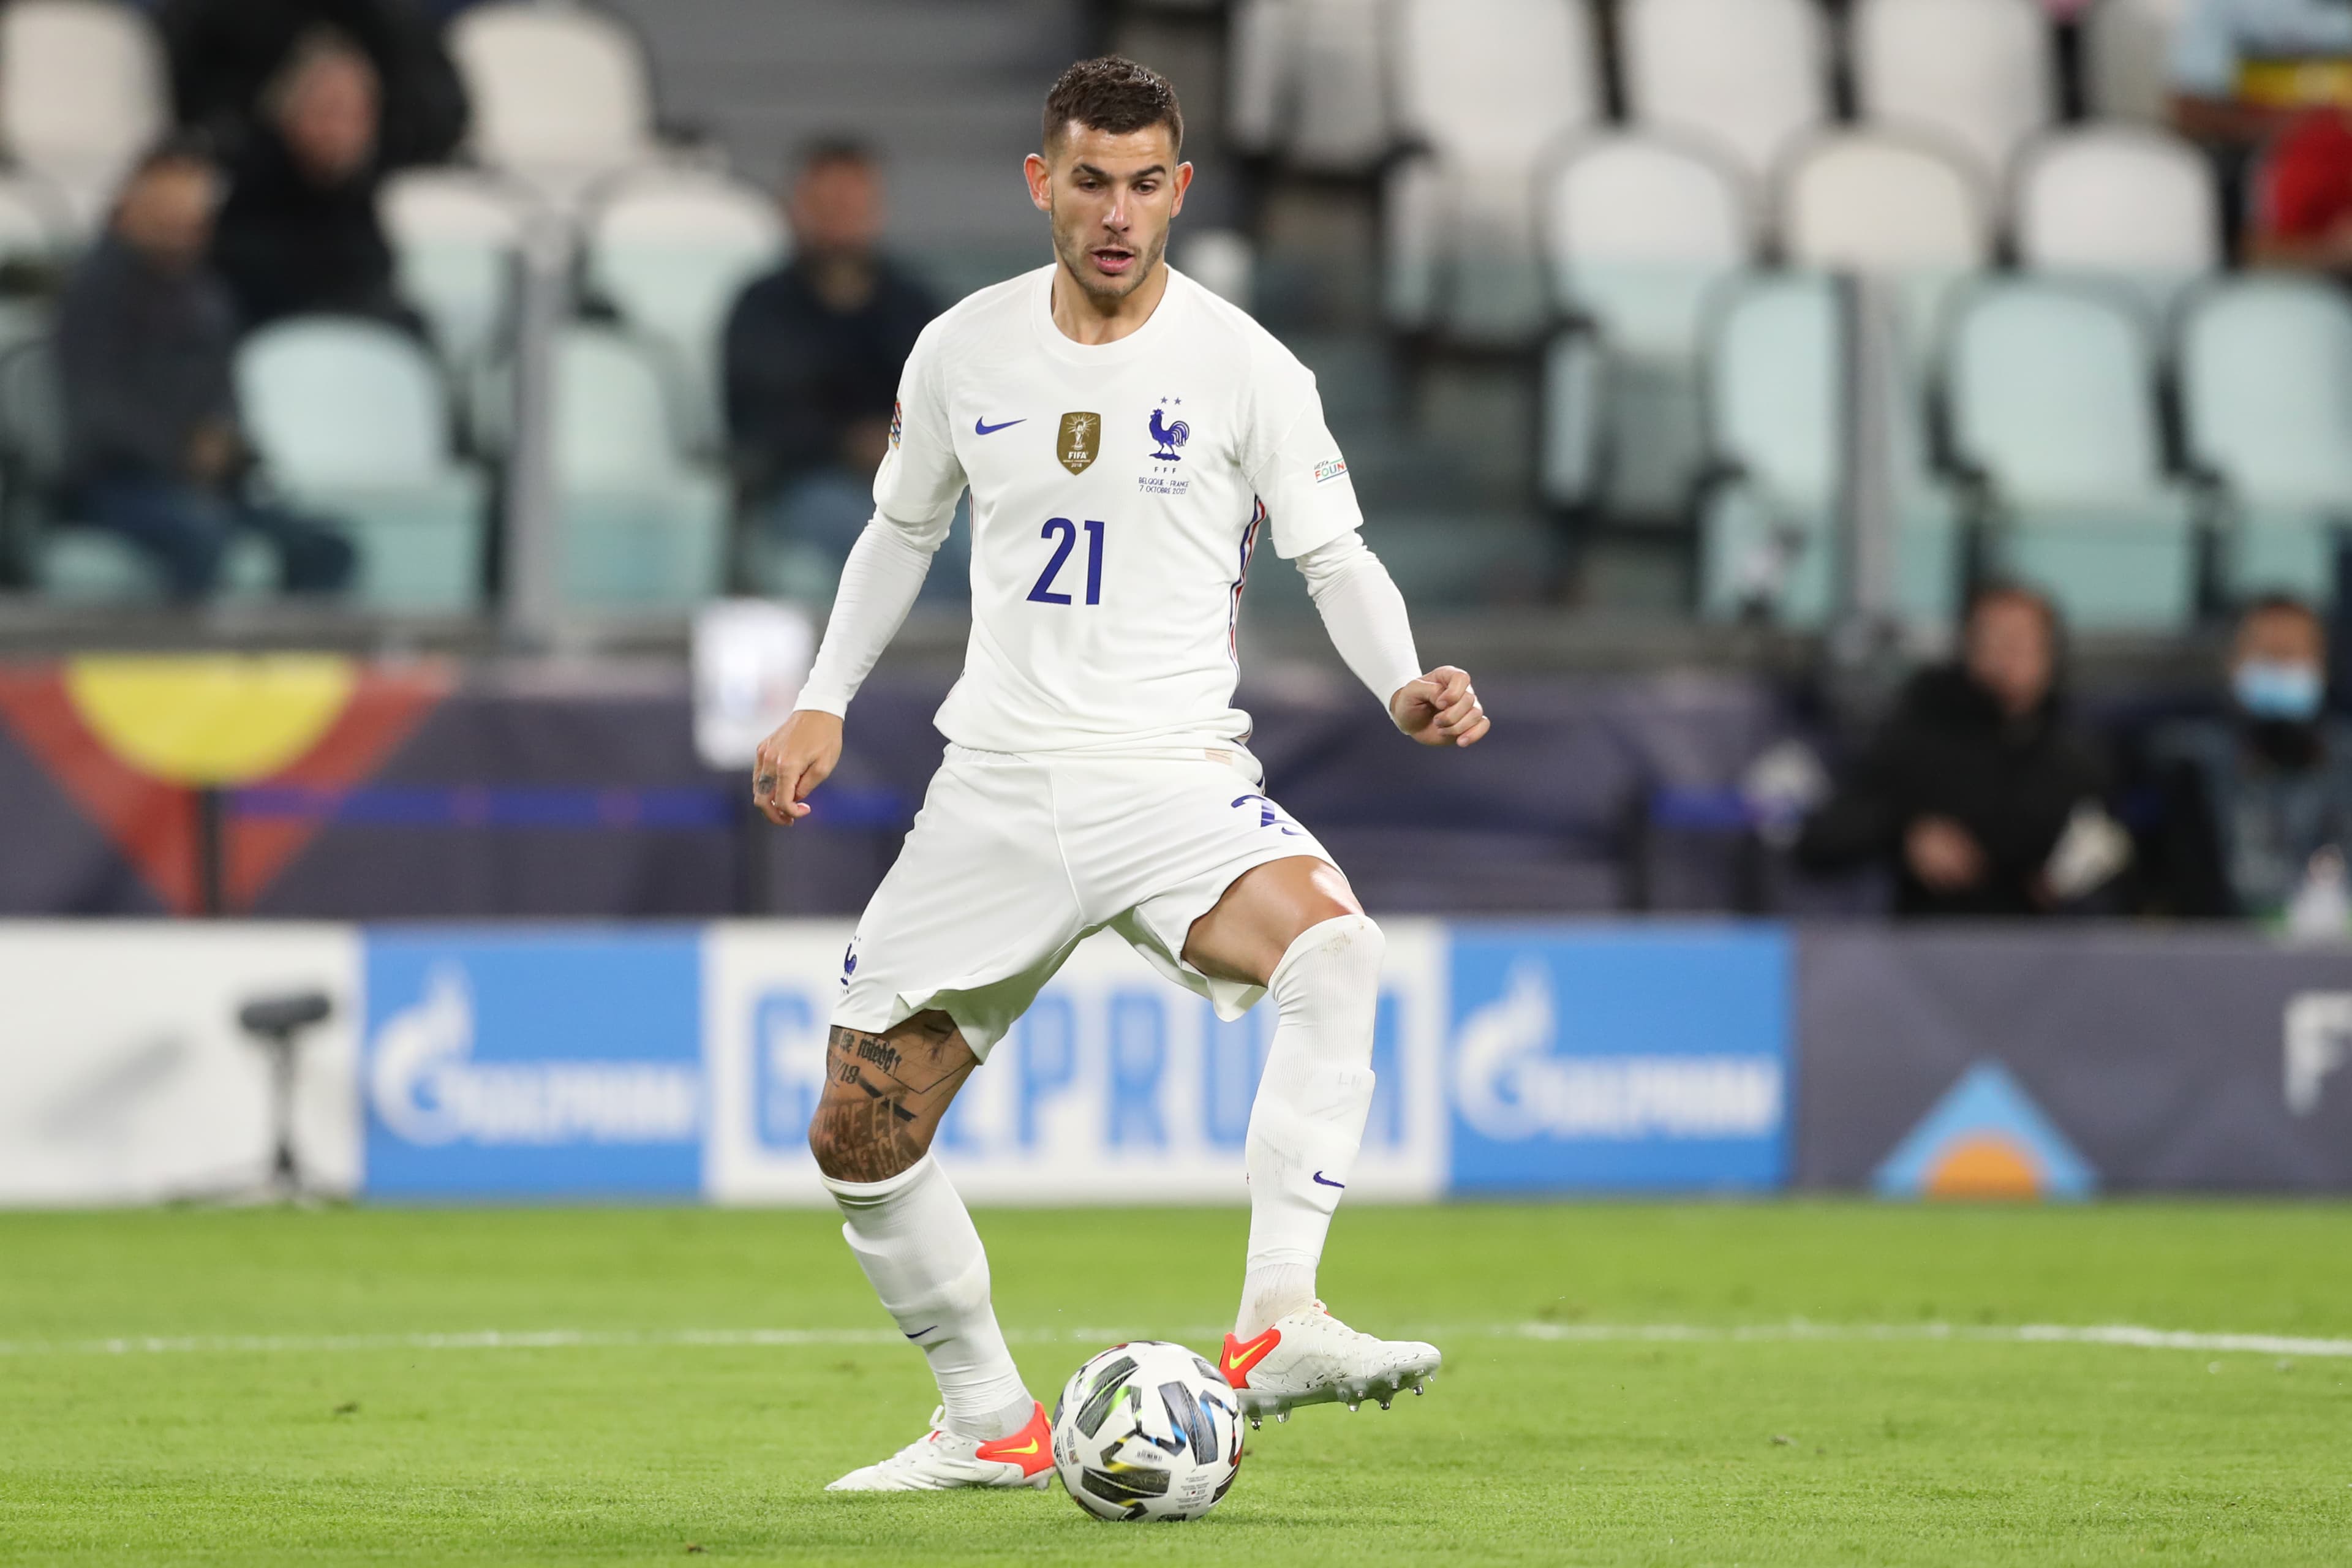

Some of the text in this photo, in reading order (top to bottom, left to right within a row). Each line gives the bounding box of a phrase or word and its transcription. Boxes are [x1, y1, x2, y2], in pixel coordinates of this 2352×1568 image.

[1068, 451, 1087, 459] FIFA
[1145, 485, 1171, 494] OCTOBRE
[1026, 517, 1105, 606] 21
